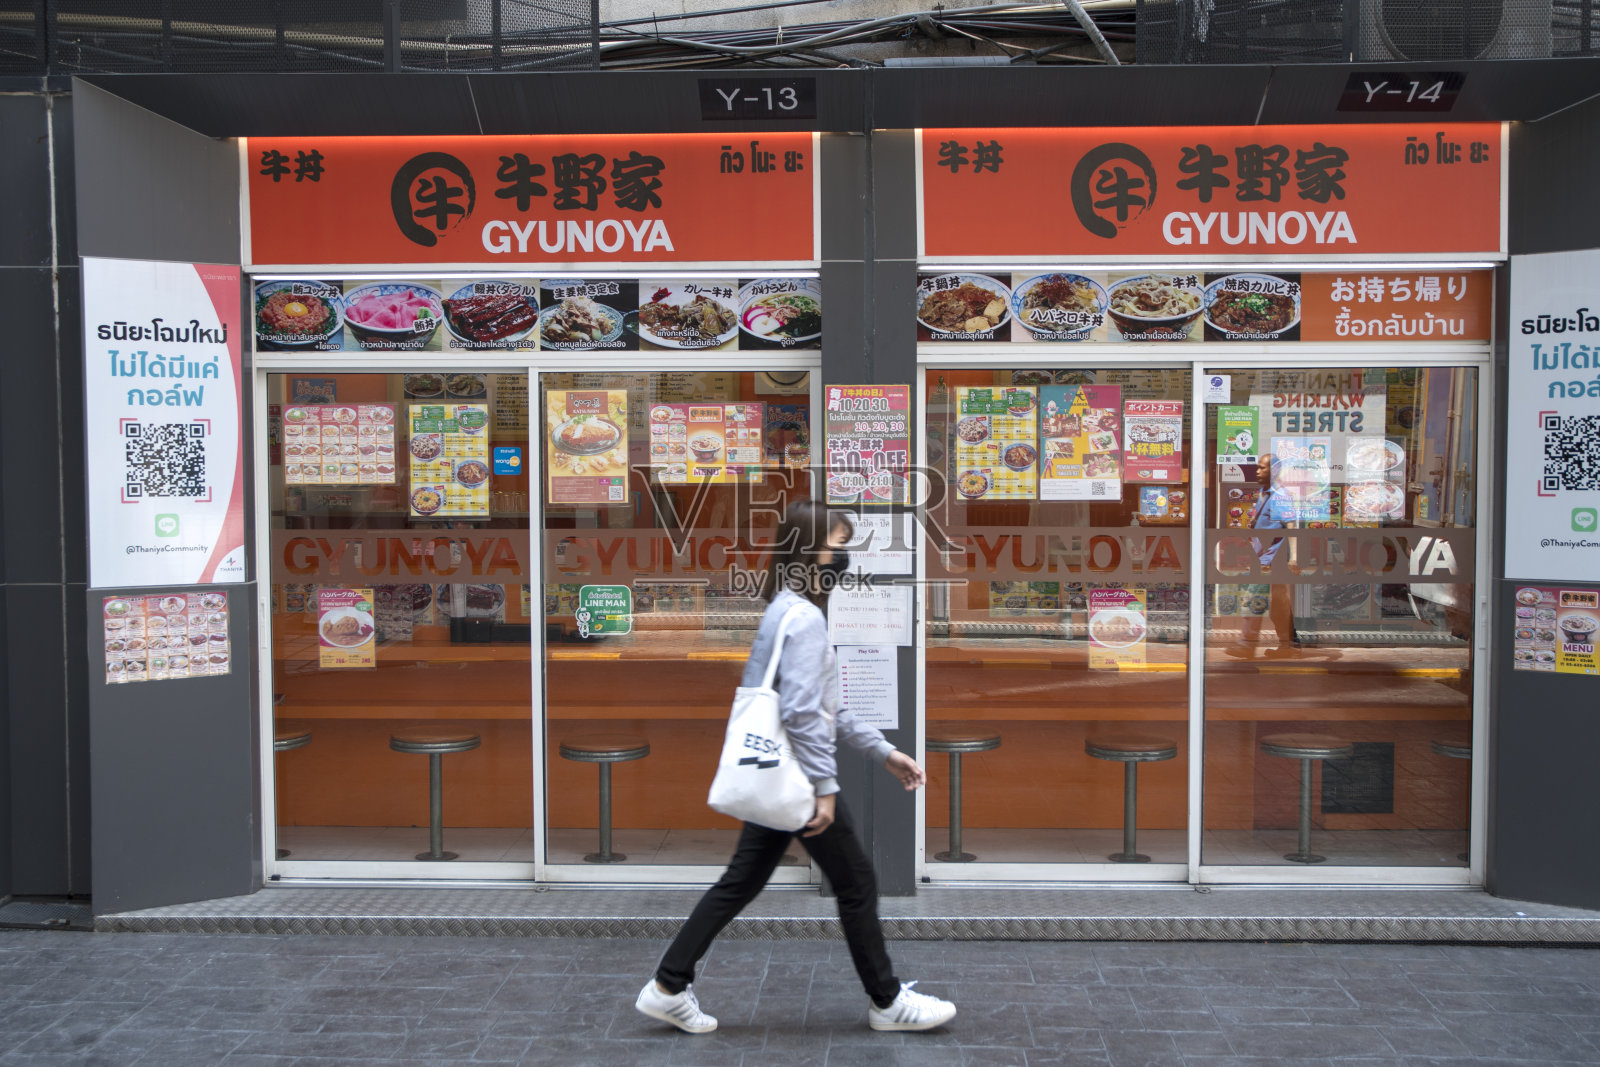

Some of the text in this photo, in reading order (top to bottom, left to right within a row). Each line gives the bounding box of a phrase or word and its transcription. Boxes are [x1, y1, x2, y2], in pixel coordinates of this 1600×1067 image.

[715, 86, 799, 111] Y-13
[1362, 80, 1444, 103] Y-14
[784, 150, 804, 174] ยะ
[937, 141, 1004, 174] 牛丼
[1469, 141, 1490, 165] ยะ
[259, 149, 325, 183] 牛丼
[1176, 142, 1350, 204] 牛野家
[493, 152, 666, 212] 牛野家
[481, 219, 674, 255] GYUNOYA
[1162, 211, 1357, 246] GYUNOYA
[553, 282, 620, 300] 生姜焼き定食
[684, 283, 733, 299] カレー牛丼
[751, 282, 798, 296] かけうどん
[922, 276, 961, 291] 牛鍋丼
[1172, 275, 1198, 289] 牛丼
[1224, 278, 1300, 297] 焼肉カルビ丼
[1330, 276, 1468, 303] お持ち帰り
[414, 318, 435, 333] 鮪丼
[1030, 309, 1104, 327] ハバネロ牛丼
[1335, 306, 1465, 337] ซื้อกลับบ้าน
[97, 318, 228, 345] ธนิยะโฉมใหม่
[107, 349, 219, 379] ไม่ได้มีแค่
[127, 383, 204, 407] กอล์ฟ
[125, 543, 209, 556] @ThaniyaCommunity
[283, 536, 522, 577] GYUNOYA
[555, 536, 773, 577] GYUNOY
[585, 599, 604, 607] LINE
[1563, 643, 1594, 653] MENU
